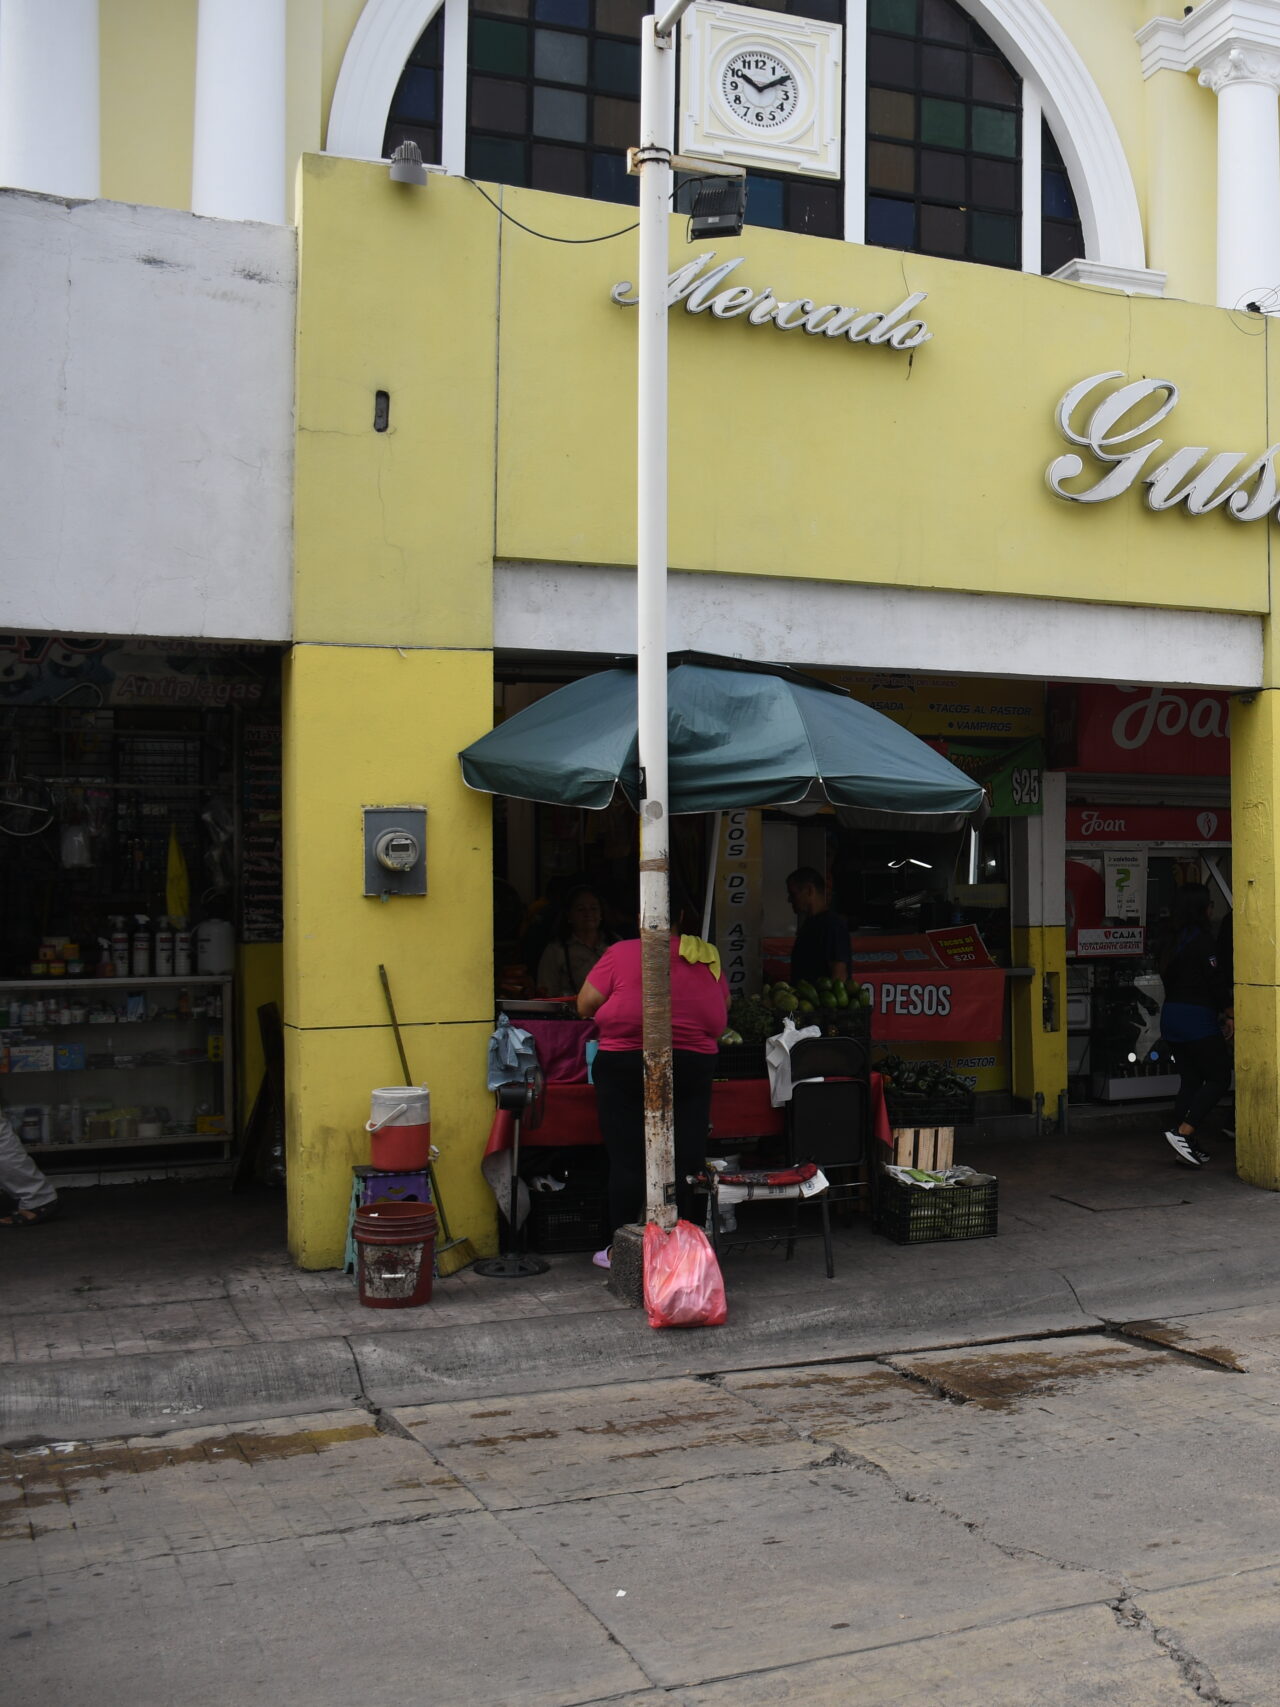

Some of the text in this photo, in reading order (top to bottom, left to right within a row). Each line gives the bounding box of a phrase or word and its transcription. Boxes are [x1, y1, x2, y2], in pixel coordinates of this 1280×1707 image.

[742, 59, 752, 70] 11
[755, 59, 767, 70] 12
[731, 68, 743, 79] 10
[771, 66, 776, 76] 1
[730, 81, 739, 91] 9
[733, 95, 742, 105] 8
[781, 90, 790, 101] 3
[742, 106, 751, 117] 7
[776, 102, 785, 112] 4
[755, 111, 764, 122] 6
[768, 110, 776, 121] 5
[610, 251, 934, 350] Mercado
[117, 674, 262, 703] Antiplagas
[936, 703, 1032, 716] TACOS AL PASTOR
[1112, 685, 1230, 750] Joa
[956, 721, 1012, 732] VAMPIROS
[1012, 767, 1040, 806] $25
[1080, 810, 1127, 836] Joan
[728, 812, 745, 856] COS
[729, 876, 745, 903] DE
[937, 939, 964, 947] Tacos
[953, 953, 976, 961] $20
[881, 983, 951, 1016] PESOS
[956, 1056, 995, 1068] PASTOR
